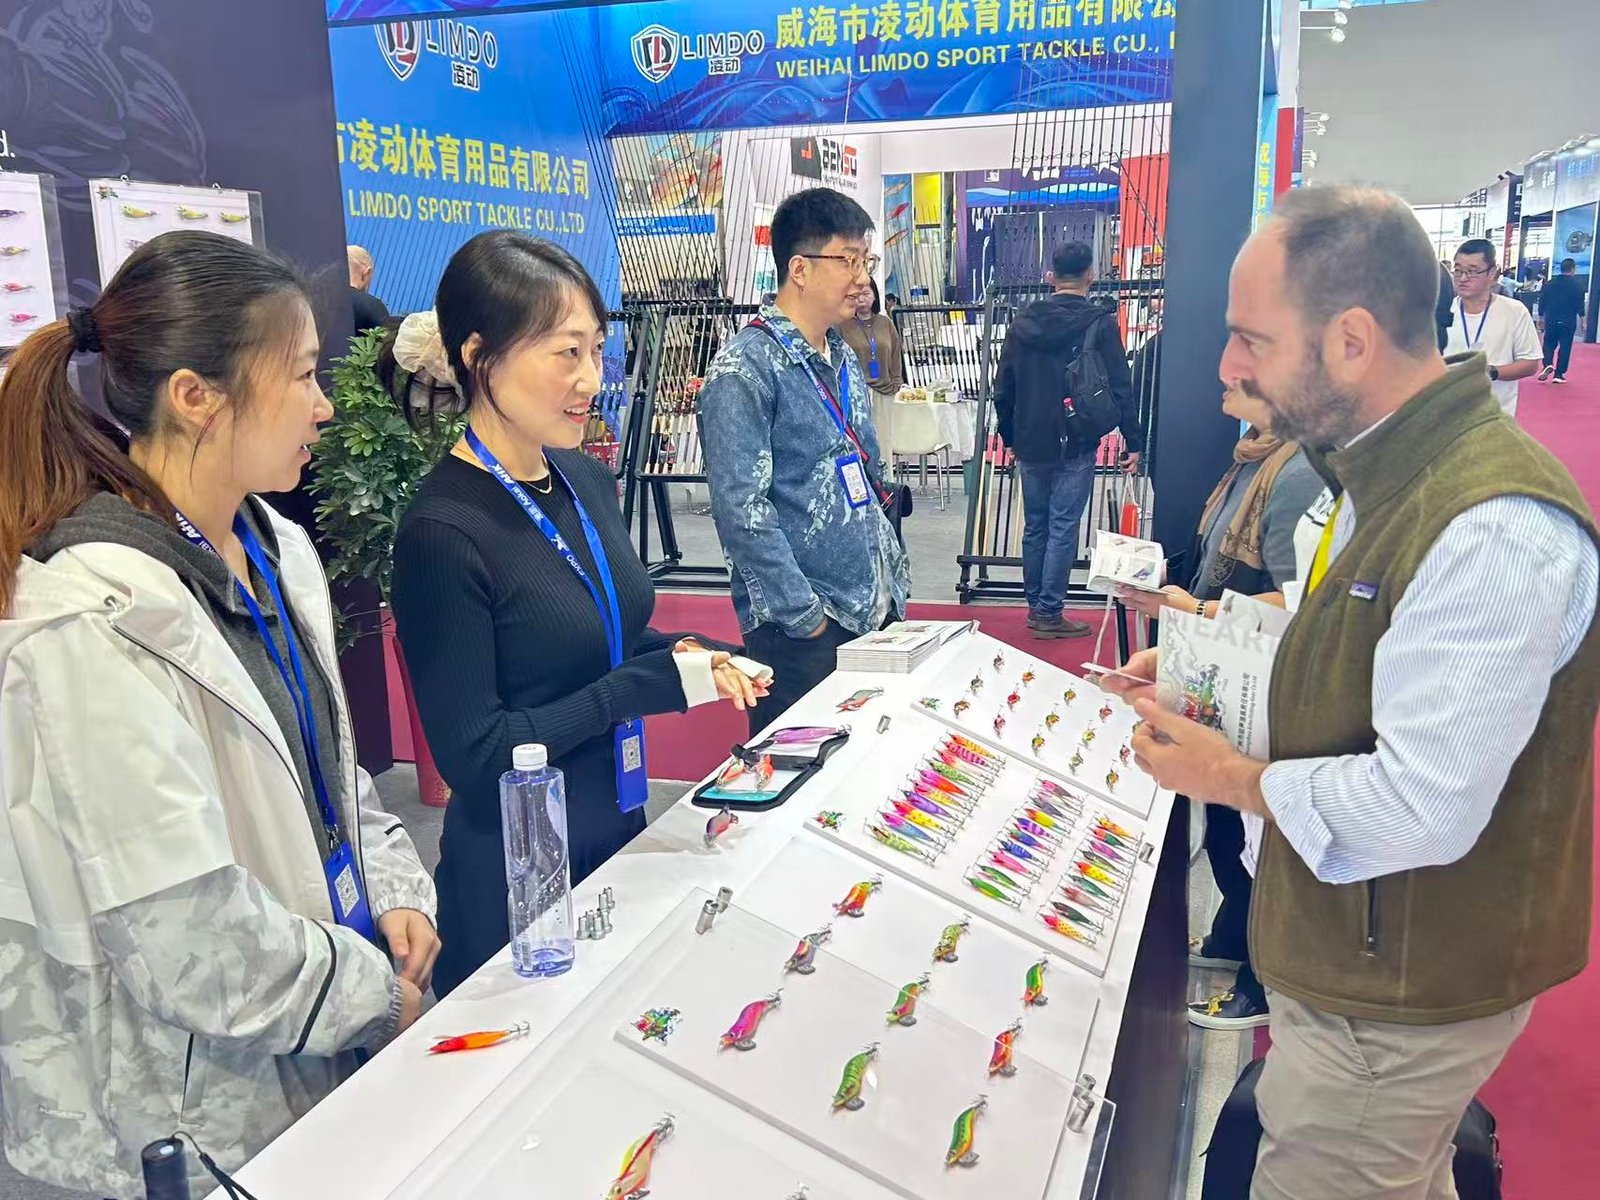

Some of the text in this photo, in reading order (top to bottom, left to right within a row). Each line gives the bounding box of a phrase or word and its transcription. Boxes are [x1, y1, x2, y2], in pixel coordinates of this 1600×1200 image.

[423, 19, 498, 68] LIMDO
[682, 30, 765, 60] LIMDO
[776, 56, 852, 79] WEIHAI
[859, 51, 929, 73] LIMDO
[936, 44, 1011, 68] SPORT
[1017, 37, 1105, 61] TACKLE
[451, 61, 479, 91] 凌动
[708, 57, 741, 75] 凌动
[348, 189, 412, 220] LIMDO
[416, 196, 472, 225] SPORT
[476, 202, 532, 230] TACKLE
